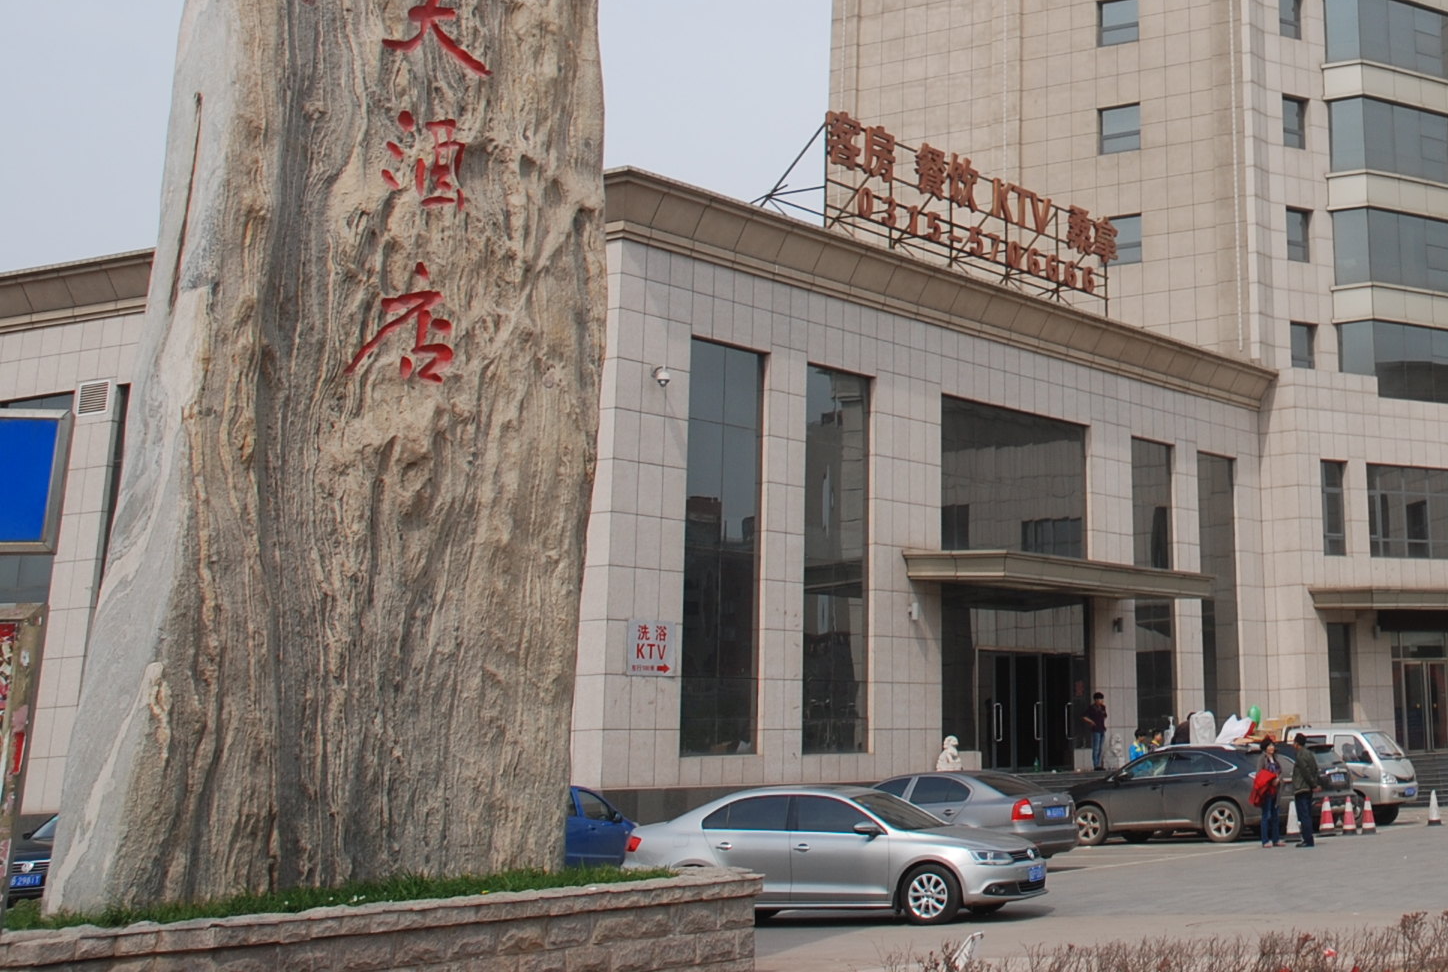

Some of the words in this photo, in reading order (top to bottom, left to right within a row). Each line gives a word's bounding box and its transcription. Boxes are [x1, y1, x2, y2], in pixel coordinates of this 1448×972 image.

[825, 110, 896, 183] 客房
[914, 141, 980, 213] 餐饮
[991, 177, 1052, 235] KTV
[1065, 204, 1119, 264] 桑拿
[857, 186, 1096, 294] 0315-5706666
[636, 643, 667, 660] KTV
[637, 623, 668, 642] 洗浴
